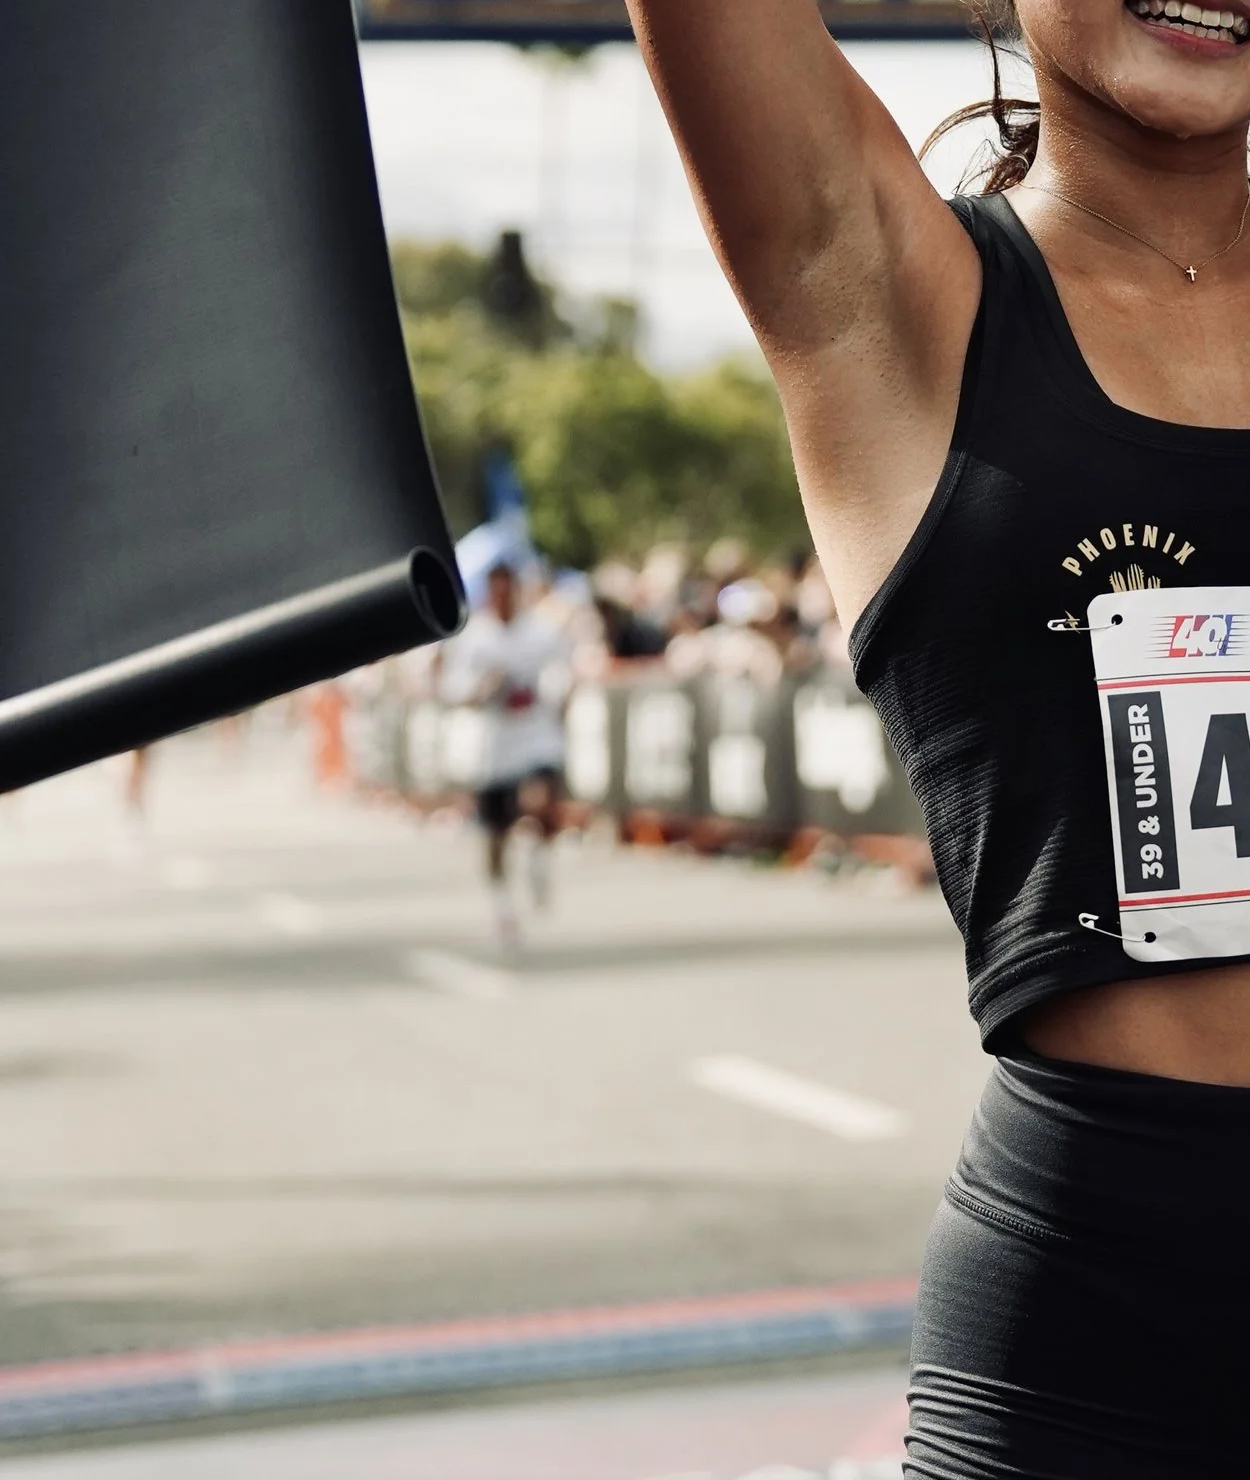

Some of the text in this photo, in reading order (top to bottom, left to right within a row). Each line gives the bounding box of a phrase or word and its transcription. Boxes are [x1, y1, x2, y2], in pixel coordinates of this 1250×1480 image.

[1061, 523, 1196, 577] PHOENIX
[1127, 703, 1165, 880] 39 & UNDER
